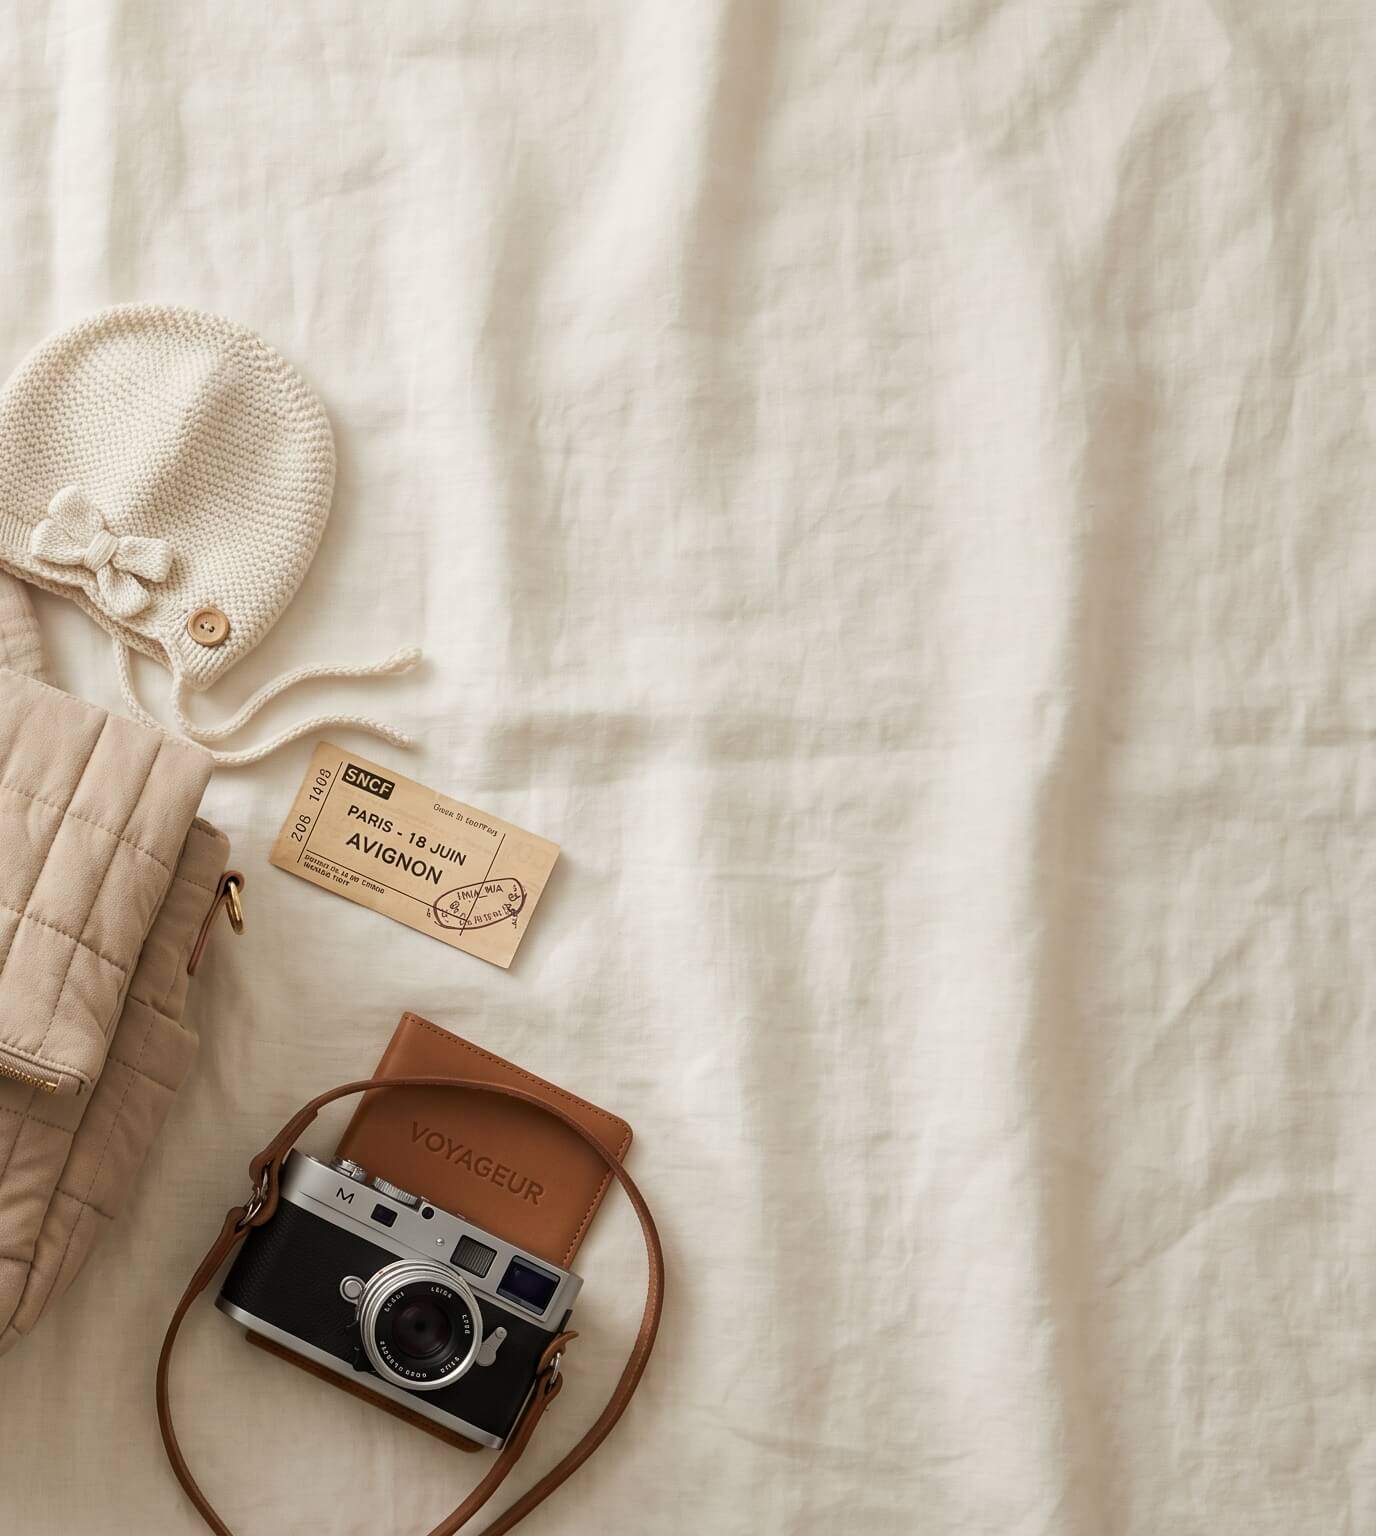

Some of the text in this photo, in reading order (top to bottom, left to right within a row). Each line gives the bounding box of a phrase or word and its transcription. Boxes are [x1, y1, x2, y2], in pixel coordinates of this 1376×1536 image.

[344, 767, 393, 796] SNCF
[290, 814, 311, 842] 206
[347, 805, 394, 833] PARIS
[408, 832, 426, 849] 18
[429, 842, 467, 867] JUIN
[345, 832, 444, 885] AVIGNON
[411, 1120, 545, 1206] VOYAGEUR
[335, 1187, 355, 1205] M
